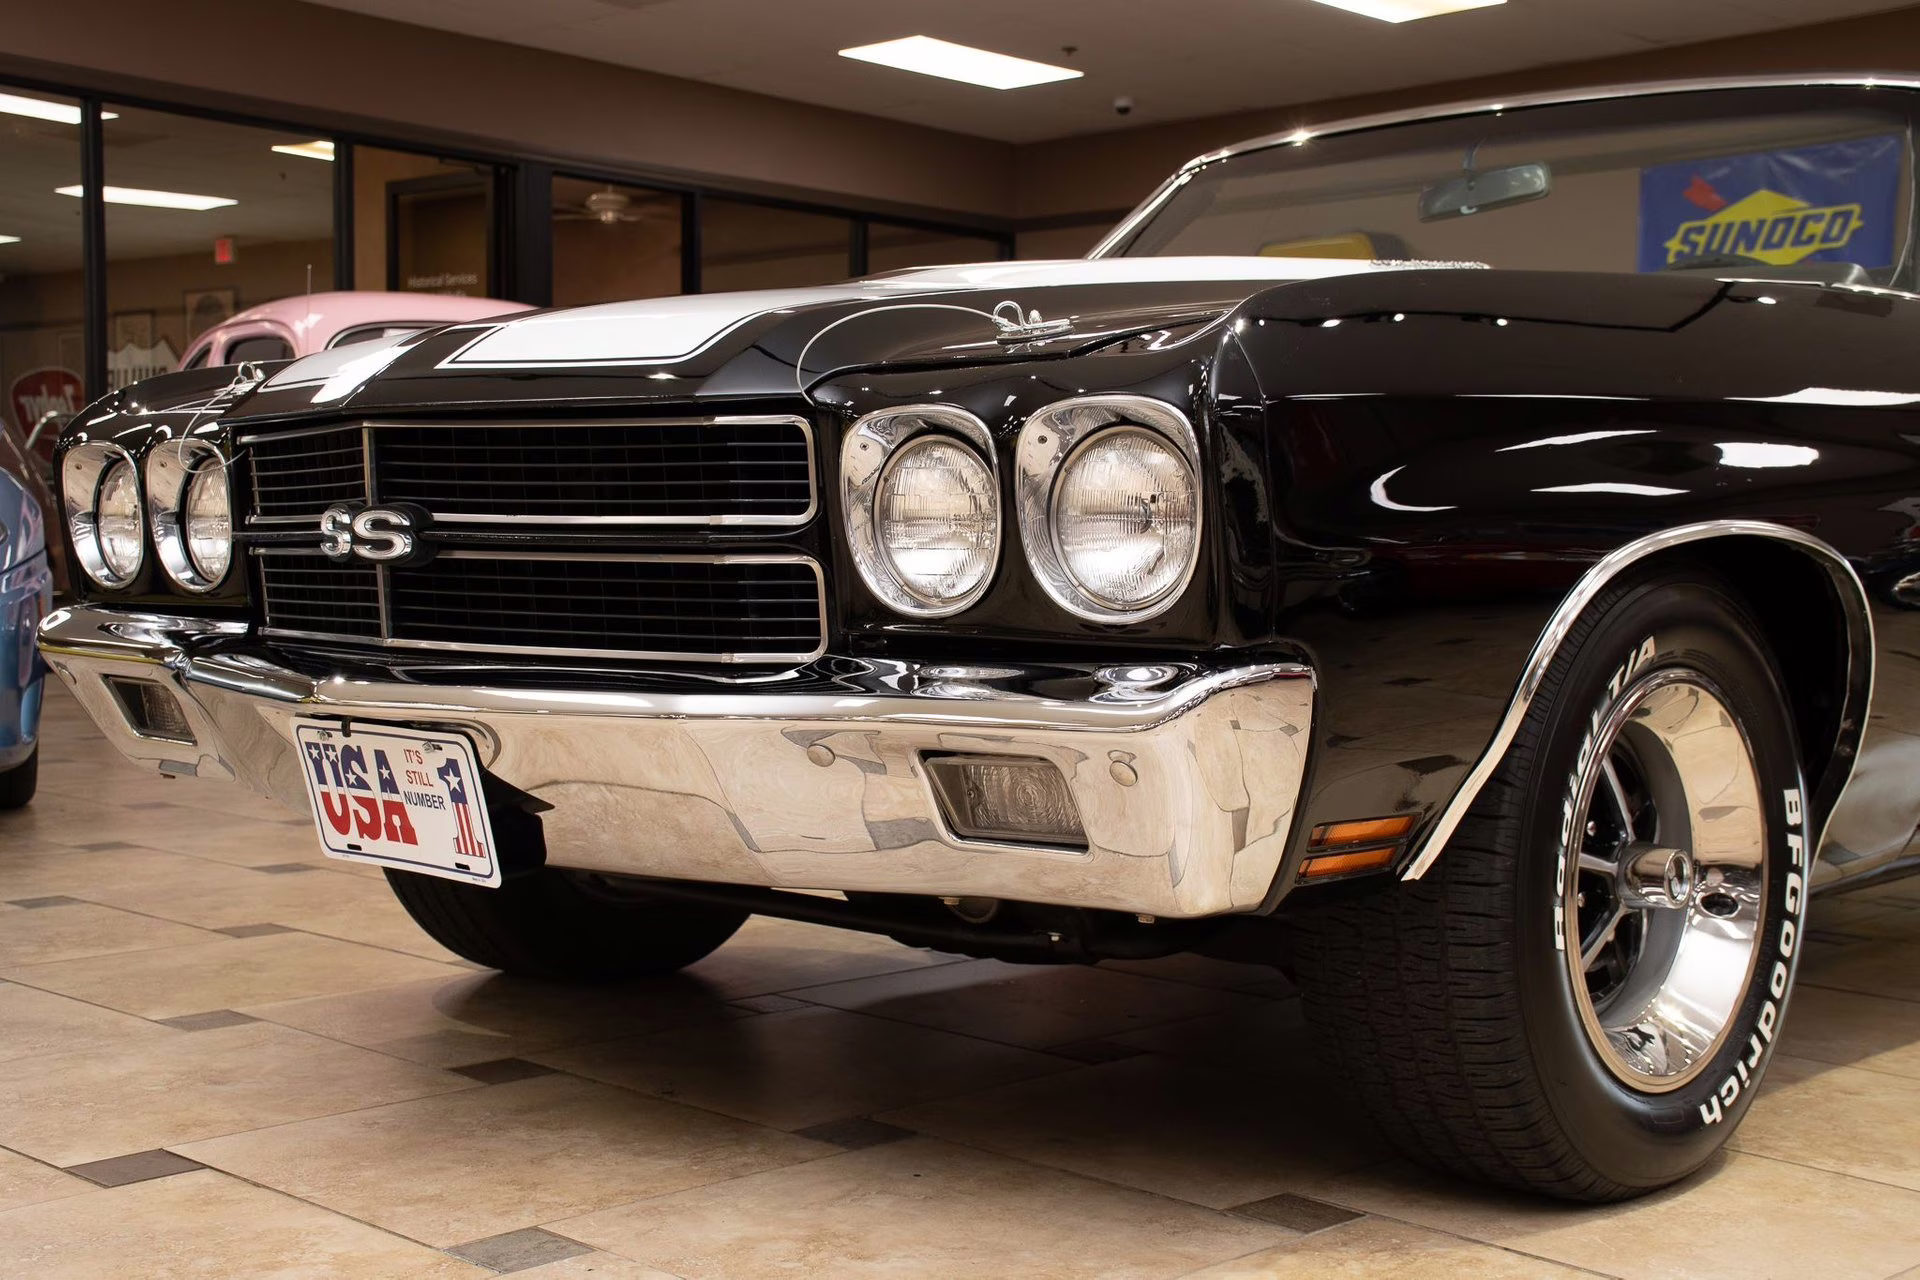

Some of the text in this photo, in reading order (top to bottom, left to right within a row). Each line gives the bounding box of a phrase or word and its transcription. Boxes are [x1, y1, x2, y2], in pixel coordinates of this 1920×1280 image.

[1677, 208, 1857, 257] SUNOCO
[320, 508, 412, 560] SS
[1607, 635, 1656, 701] T/A
[403, 747, 424, 765] IT'S
[405, 769, 434, 788] STILL
[304, 741, 419, 846] USA
[403, 790, 447, 811] NUMBER
[436, 757, 487, 859] 1
[1699, 789, 1804, 1126] BFGoodrich
